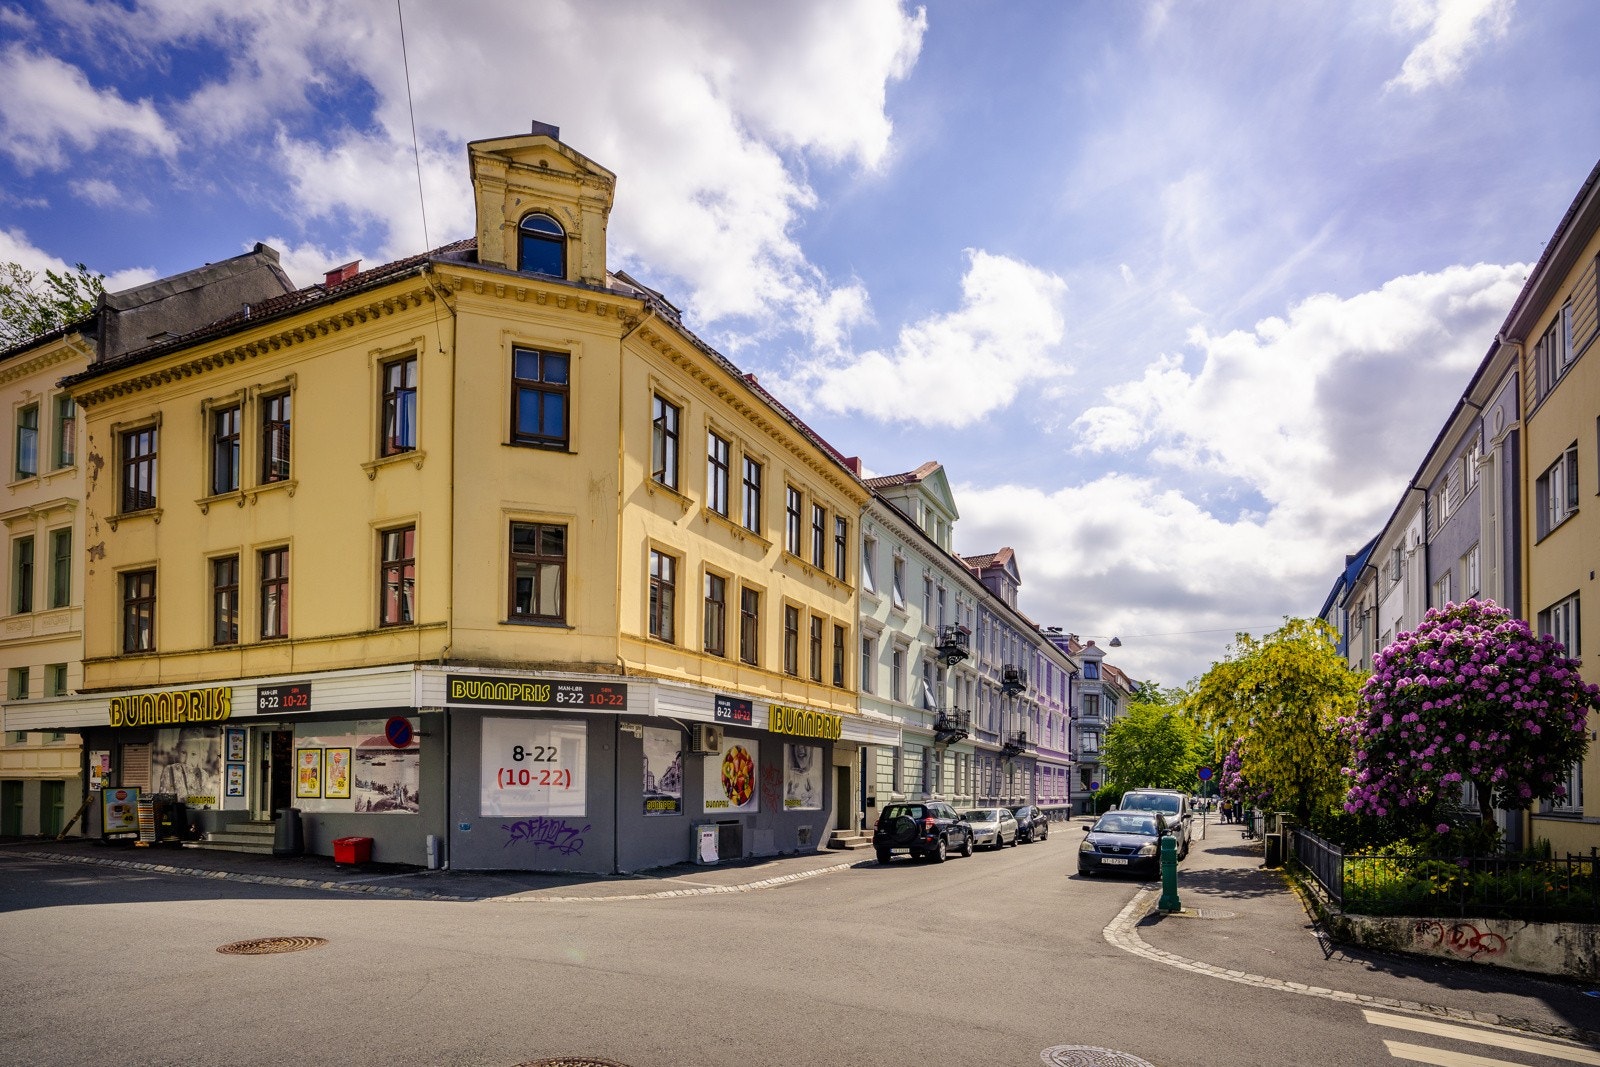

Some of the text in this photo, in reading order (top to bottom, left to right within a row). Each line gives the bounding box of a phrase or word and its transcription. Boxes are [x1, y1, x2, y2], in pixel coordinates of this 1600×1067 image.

[452, 680, 551, 702] BUNNPRIS
[260, 696, 279, 709] 8-22
[283, 694, 307, 707] 10-22
[556, 692, 584, 704] 8-22
[589, 693, 624, 706] 10-22
[109, 686, 230, 727] BUNNPRIS
[717, 706, 731, 718] 8-22
[733, 709, 750, 721] 10-22
[769, 704, 842, 740] BUNNPRIS
[512, 745, 558, 762] 8-22
[497, 767, 571, 789] (10-22)
